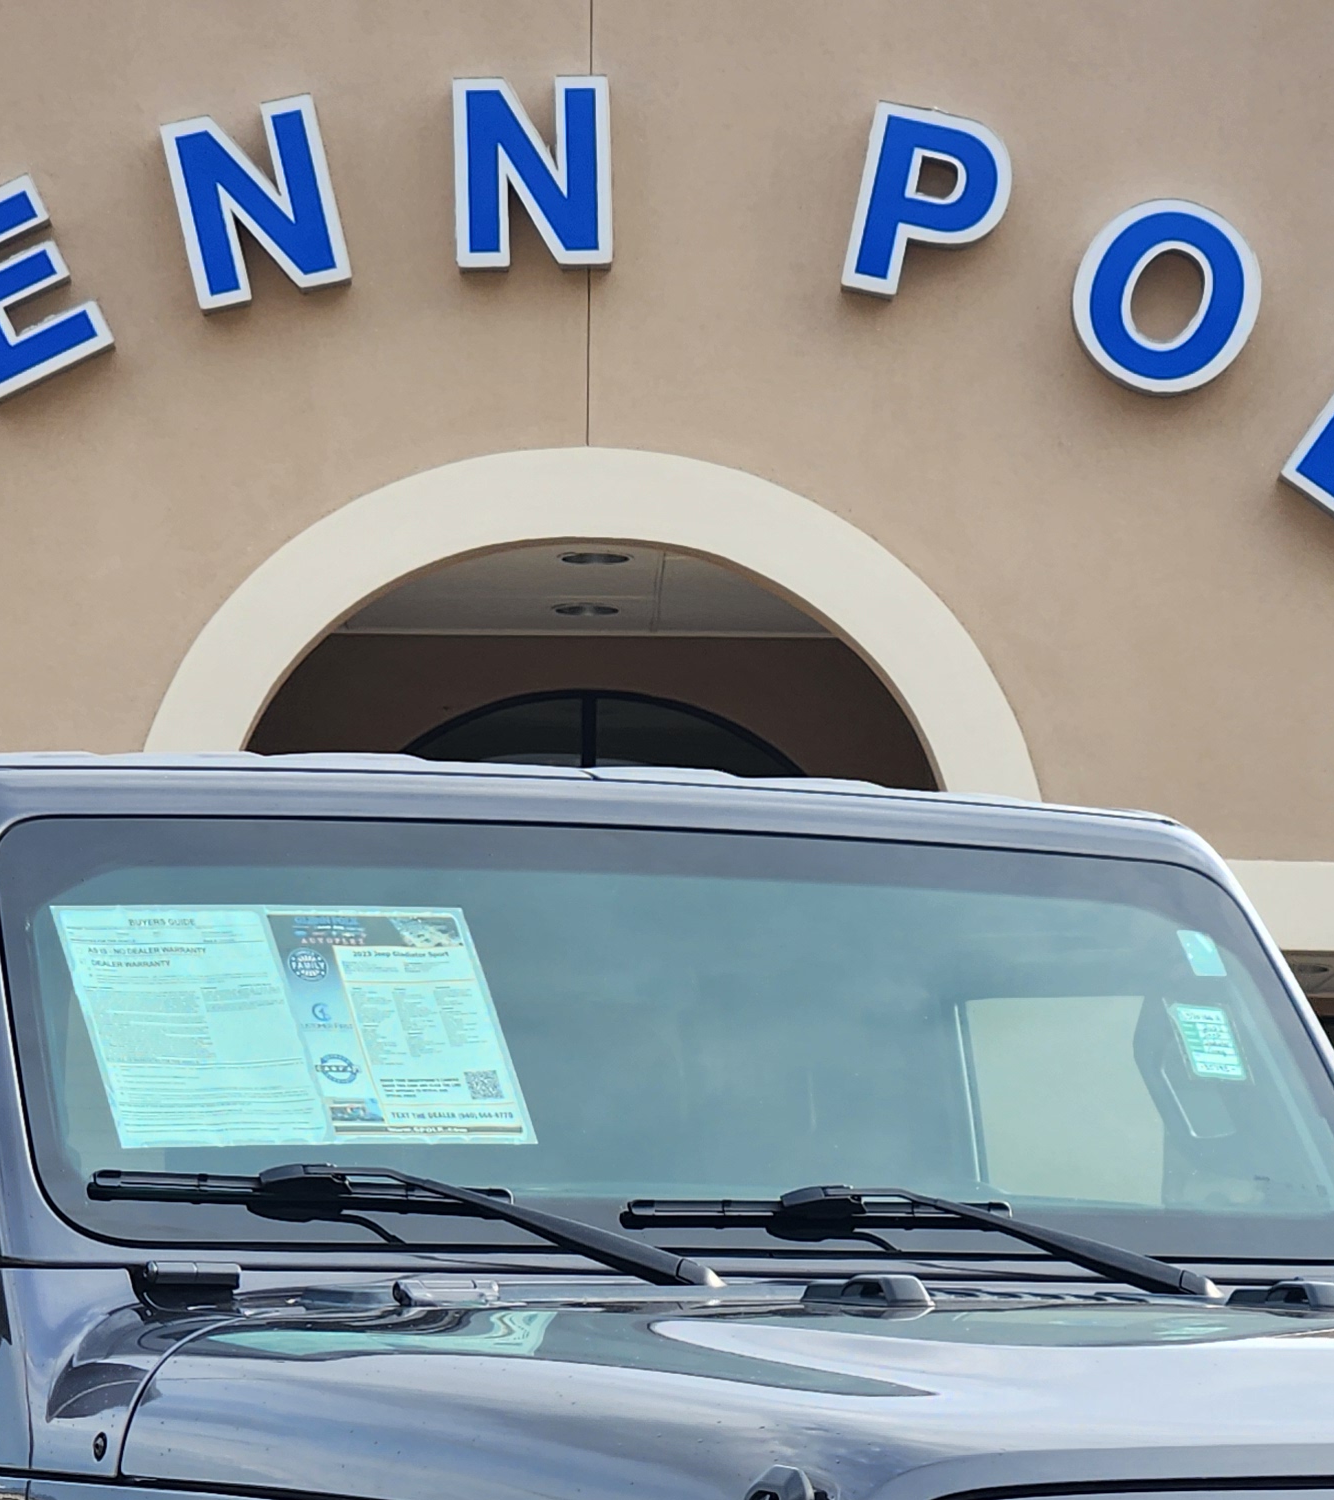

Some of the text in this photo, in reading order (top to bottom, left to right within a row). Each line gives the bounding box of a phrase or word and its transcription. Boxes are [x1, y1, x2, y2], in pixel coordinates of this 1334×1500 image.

[128, 918, 196, 927] BUYERS GUIDE
[114, 947, 126, 955] NO
[161, 946, 207, 954] WARRANTY
[92, 959, 171, 967] DEALER WARRANTY
